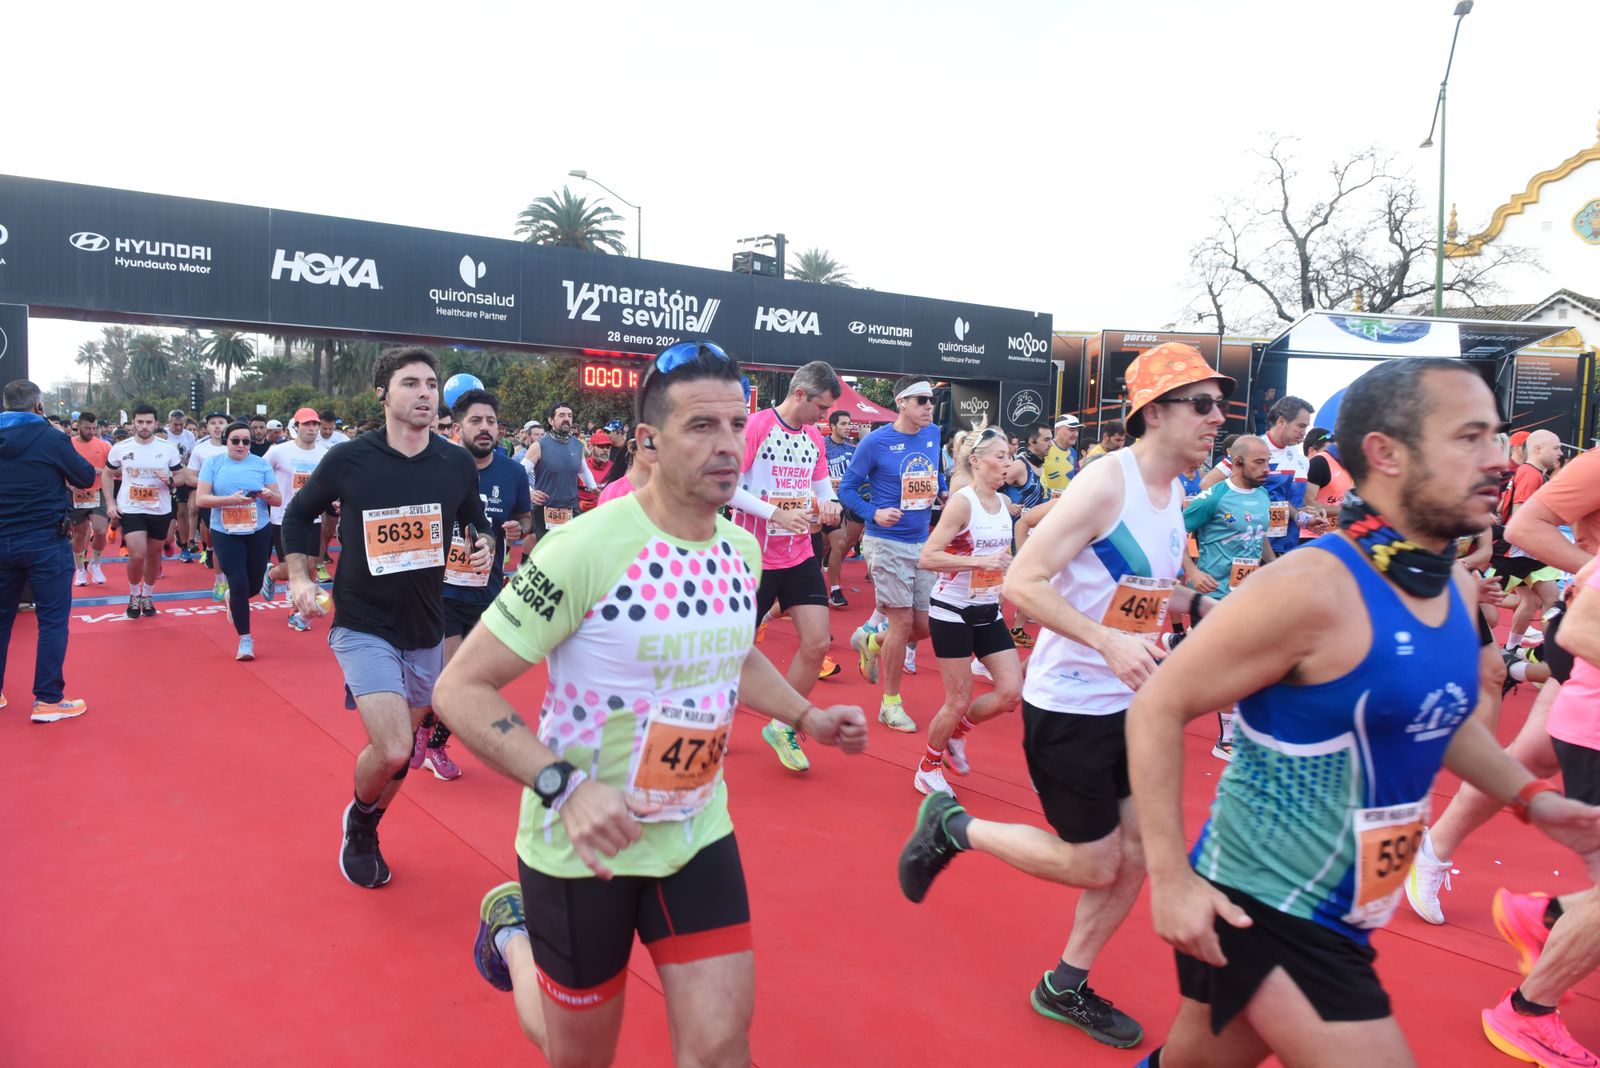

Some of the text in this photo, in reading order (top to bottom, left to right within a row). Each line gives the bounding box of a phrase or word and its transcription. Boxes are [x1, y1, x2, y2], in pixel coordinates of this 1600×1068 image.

[115, 237, 212, 261] HYUNDAI
[114, 256, 211, 274] Hyundauto Motor
[270, 248, 380, 290] HOKA
[594, 283, 698, 312] maratón
[436, 306, 508, 321] Healthcare Partner
[621, 307, 700, 332] sevilla
[754, 306, 822, 336] HOKA
[608, 331, 620, 342] 28
[624, 335, 654, 346] enero
[868, 324, 912, 338] HYUNDAI
[868, 336, 896, 346] Hyundauto
[942, 356, 964, 364] Healthcare
[134, 488, 153, 497] 5124
[908, 480, 931, 493] 5056
[409, 505, 431, 515] SEVILLA
[548, 512, 566, 520] 4947
[377, 520, 424, 544] 5633
